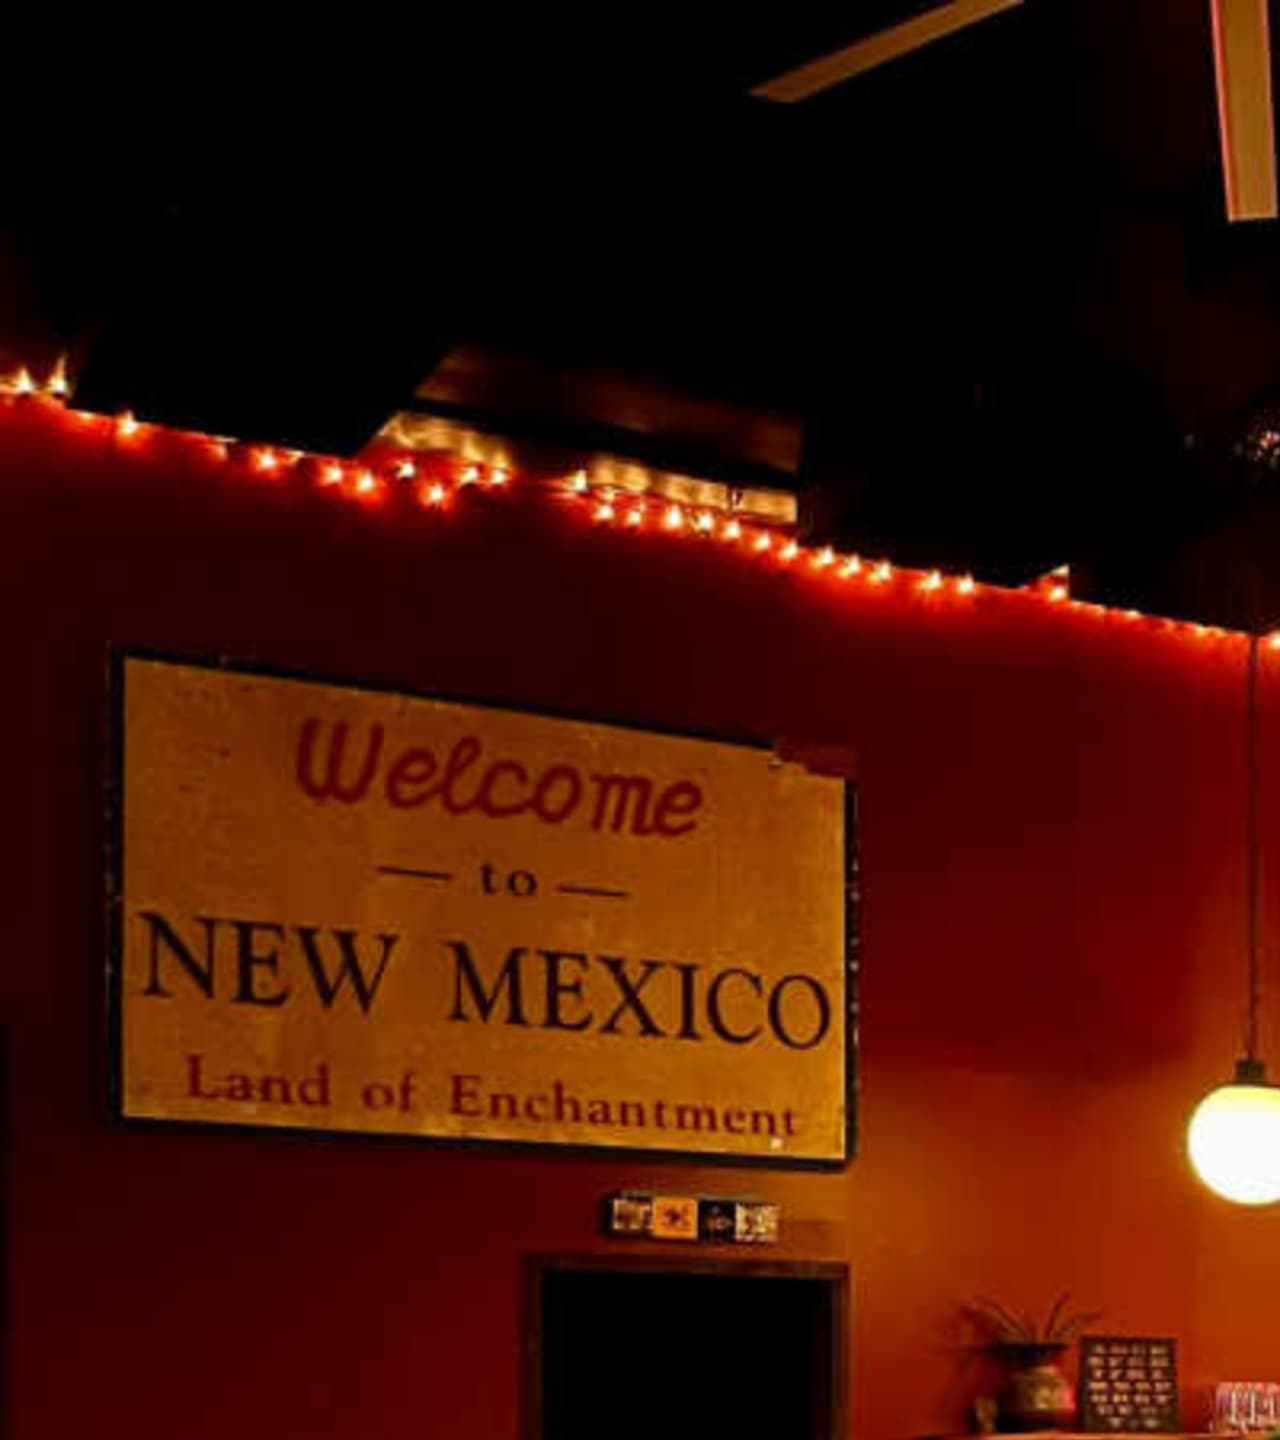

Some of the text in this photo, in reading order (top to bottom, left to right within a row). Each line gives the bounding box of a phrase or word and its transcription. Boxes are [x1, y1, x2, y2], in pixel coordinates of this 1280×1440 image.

[295, 716, 704, 838] Welcome
[480, 862, 538, 897] to
[140, 911, 831, 1050] NEW MEXICO
[186, 1053, 798, 1138] Land of Enchantment
